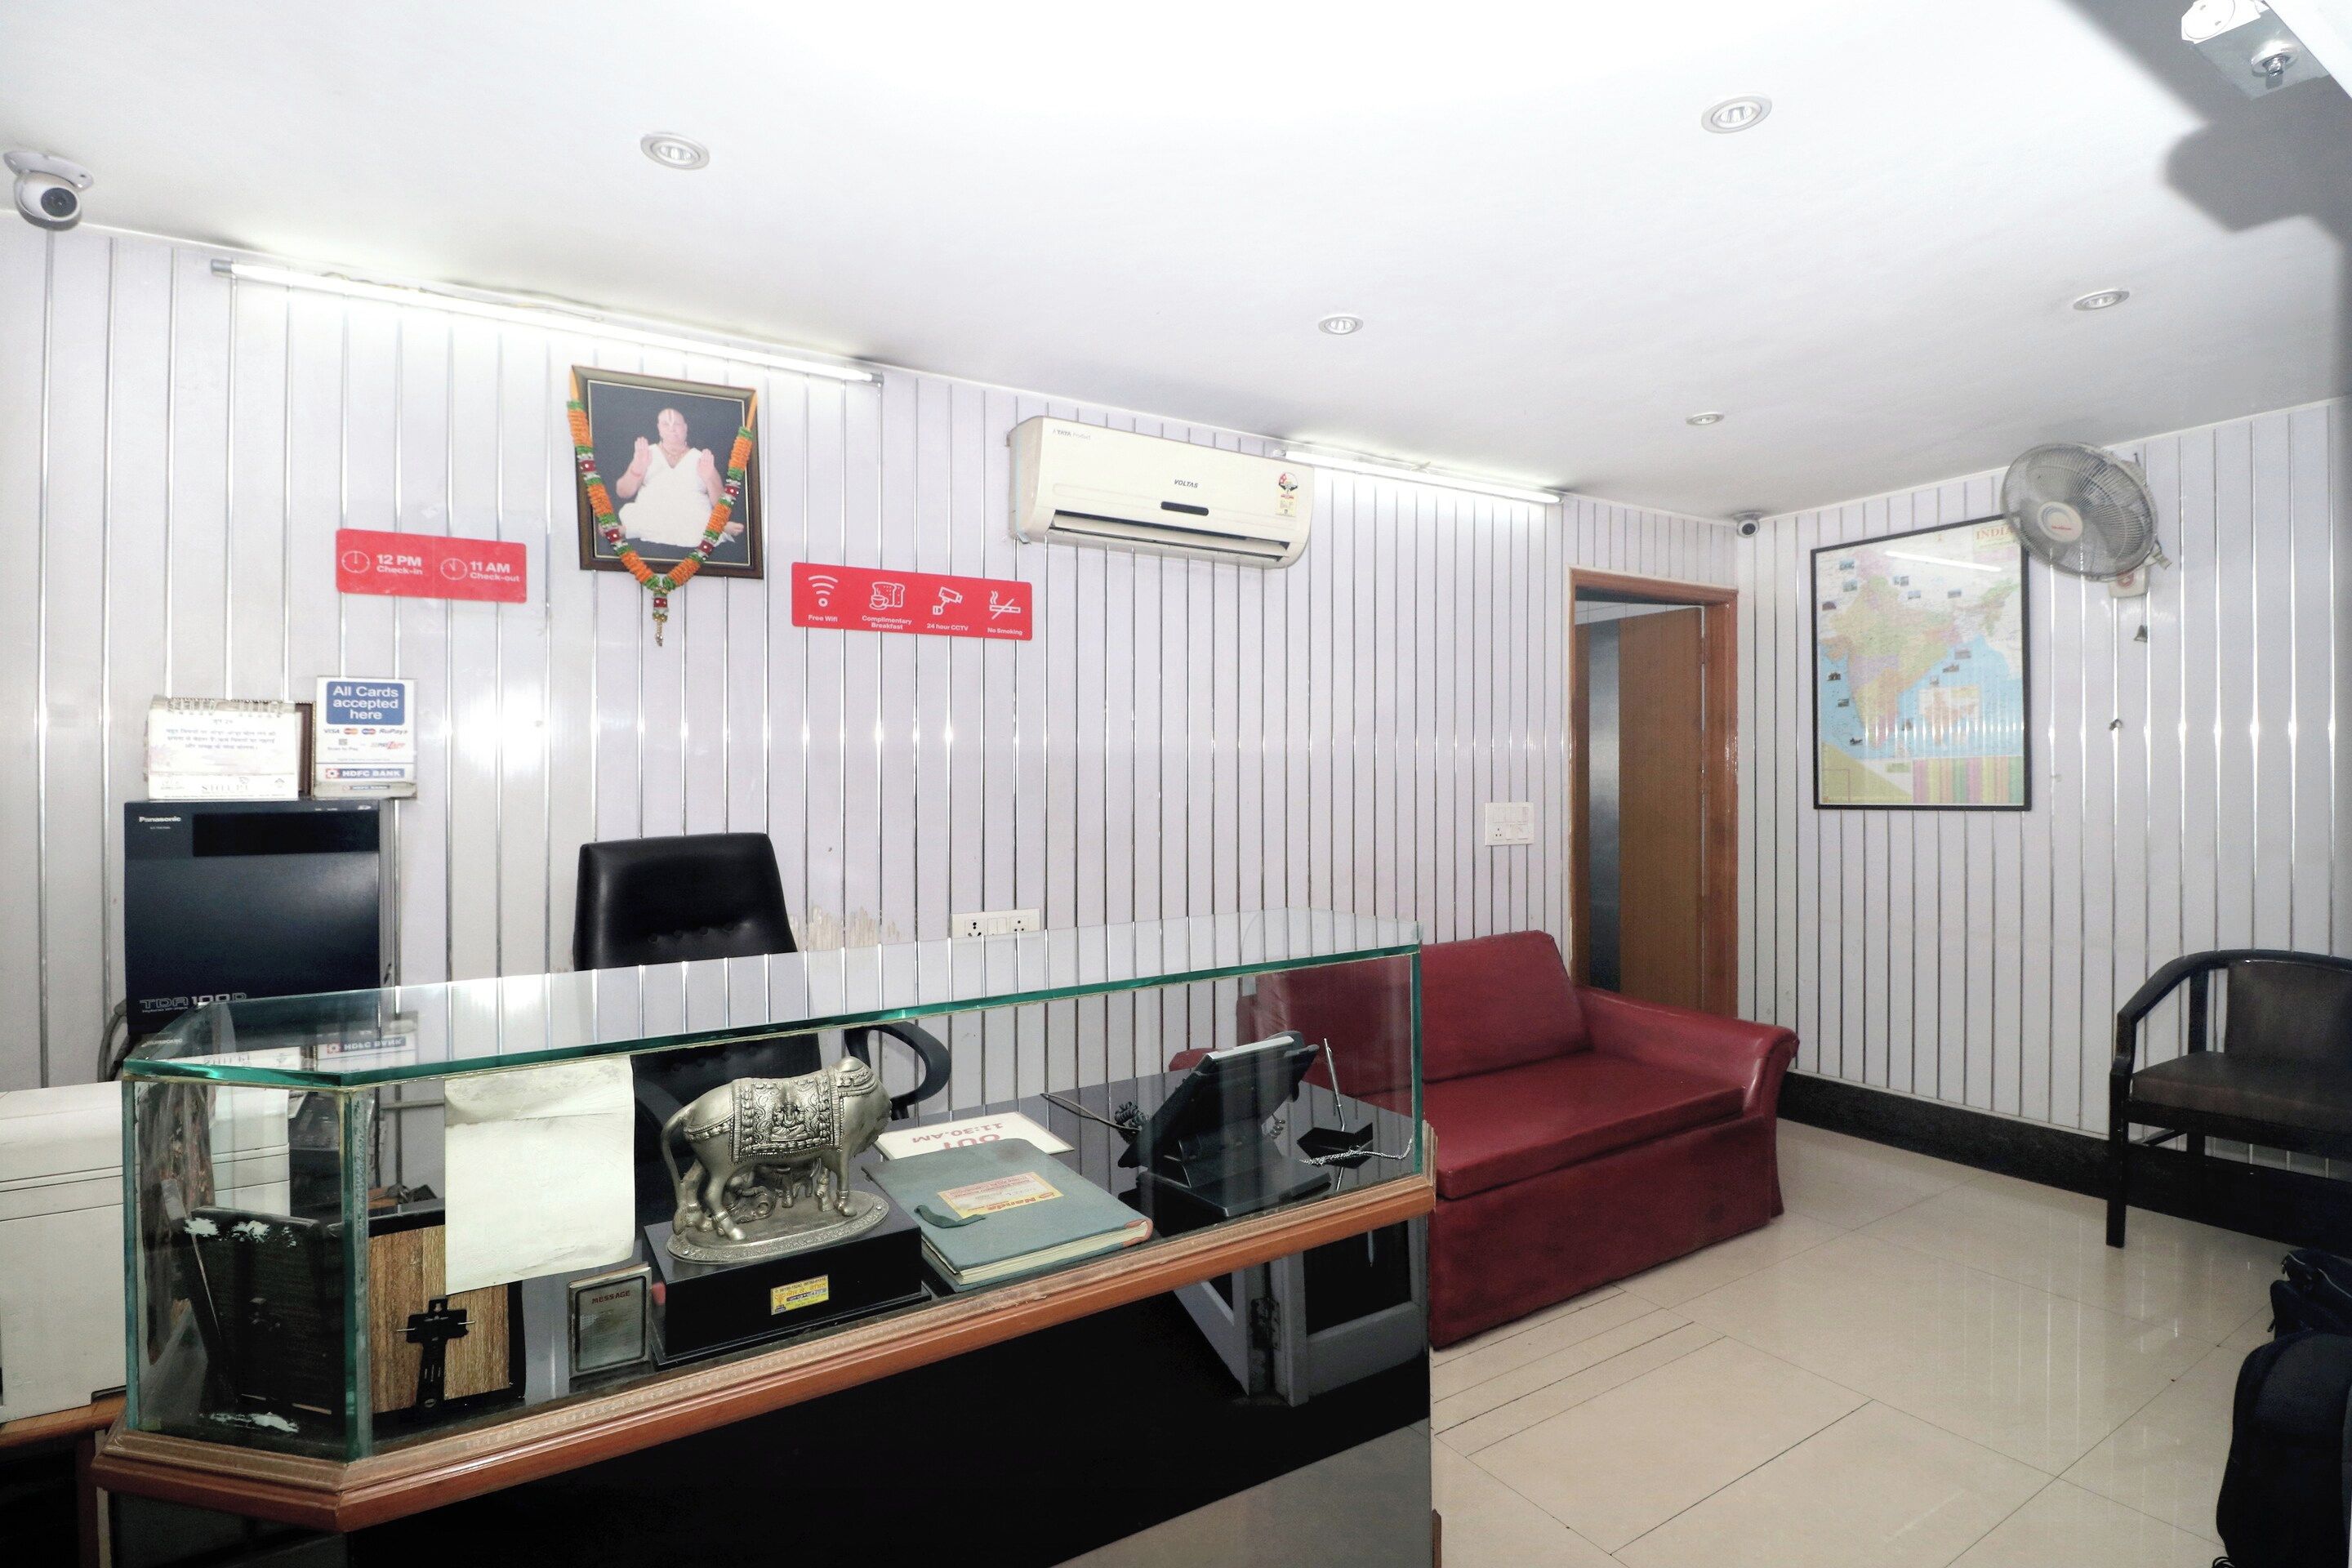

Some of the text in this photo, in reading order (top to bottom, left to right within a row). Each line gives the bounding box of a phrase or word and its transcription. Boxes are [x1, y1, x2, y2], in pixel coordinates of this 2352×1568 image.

[1174, 479, 1199, 488] VOLTAS
[376, 554, 422, 567] 12 PM
[376, 565, 423, 576] Check-in
[470, 561, 510, 573] 11 AM
[470, 572, 519, 582] Check-out
[862, 615, 912, 626] Complimentary
[871, 622, 903, 630] Breakfast
[996, 628, 1023, 636] Smoking
[333, 686, 399, 697] All Cards
[333, 698, 399, 710] accepted
[350, 709, 383, 720] here
[342, 769, 401, 778] HDFC BANK
[591, 1290, 631, 1304] MESSAGE
